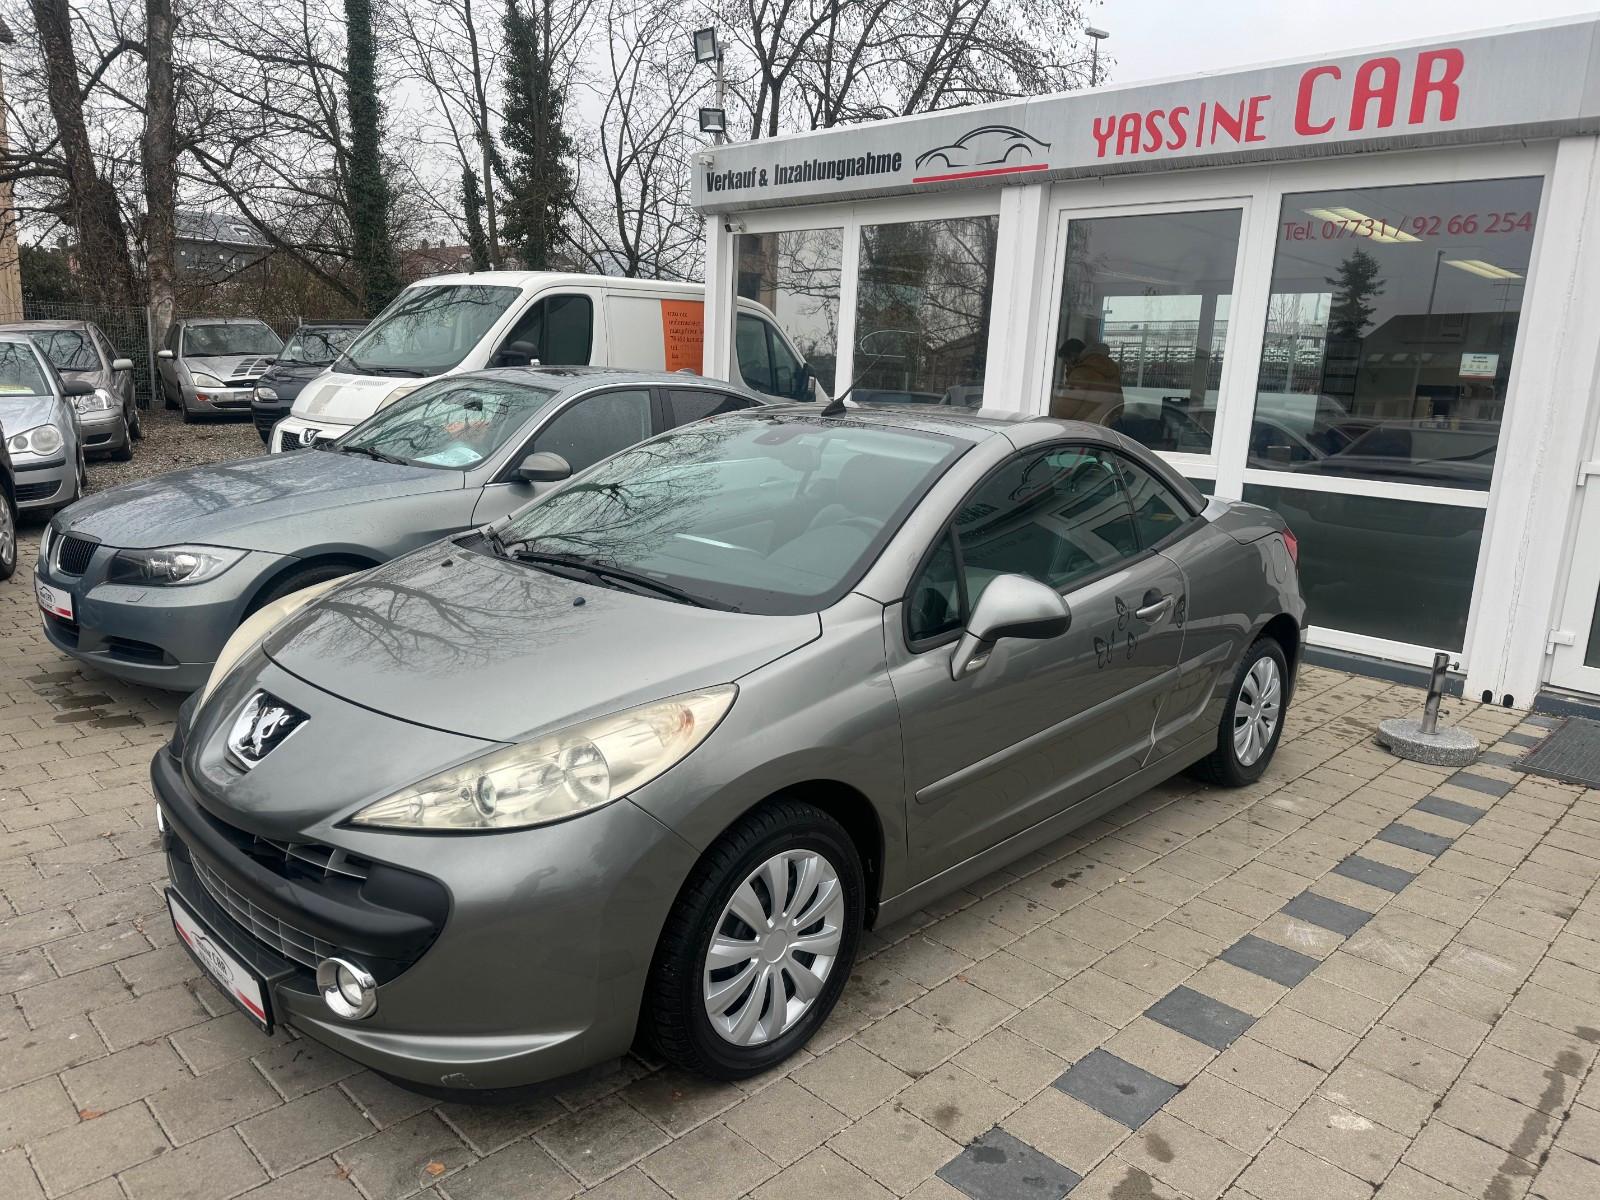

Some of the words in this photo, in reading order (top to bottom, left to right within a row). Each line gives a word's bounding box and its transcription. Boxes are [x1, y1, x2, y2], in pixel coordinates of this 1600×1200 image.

[1092, 95, 1271, 158] YASSINE
[1294, 47, 1465, 136] CAR
[706, 167, 757, 192] Verkauf
[758, 168, 769, 187] &
[773, 151, 902, 186] Inzahlungnahme
[1284, 221, 1316, 241] Tel.
[1321, 217, 1387, 240] 07731
[1411, 214, 1443, 236] 92
[1447, 213, 1479, 235] 66
[1483, 210, 1534, 234] 254
